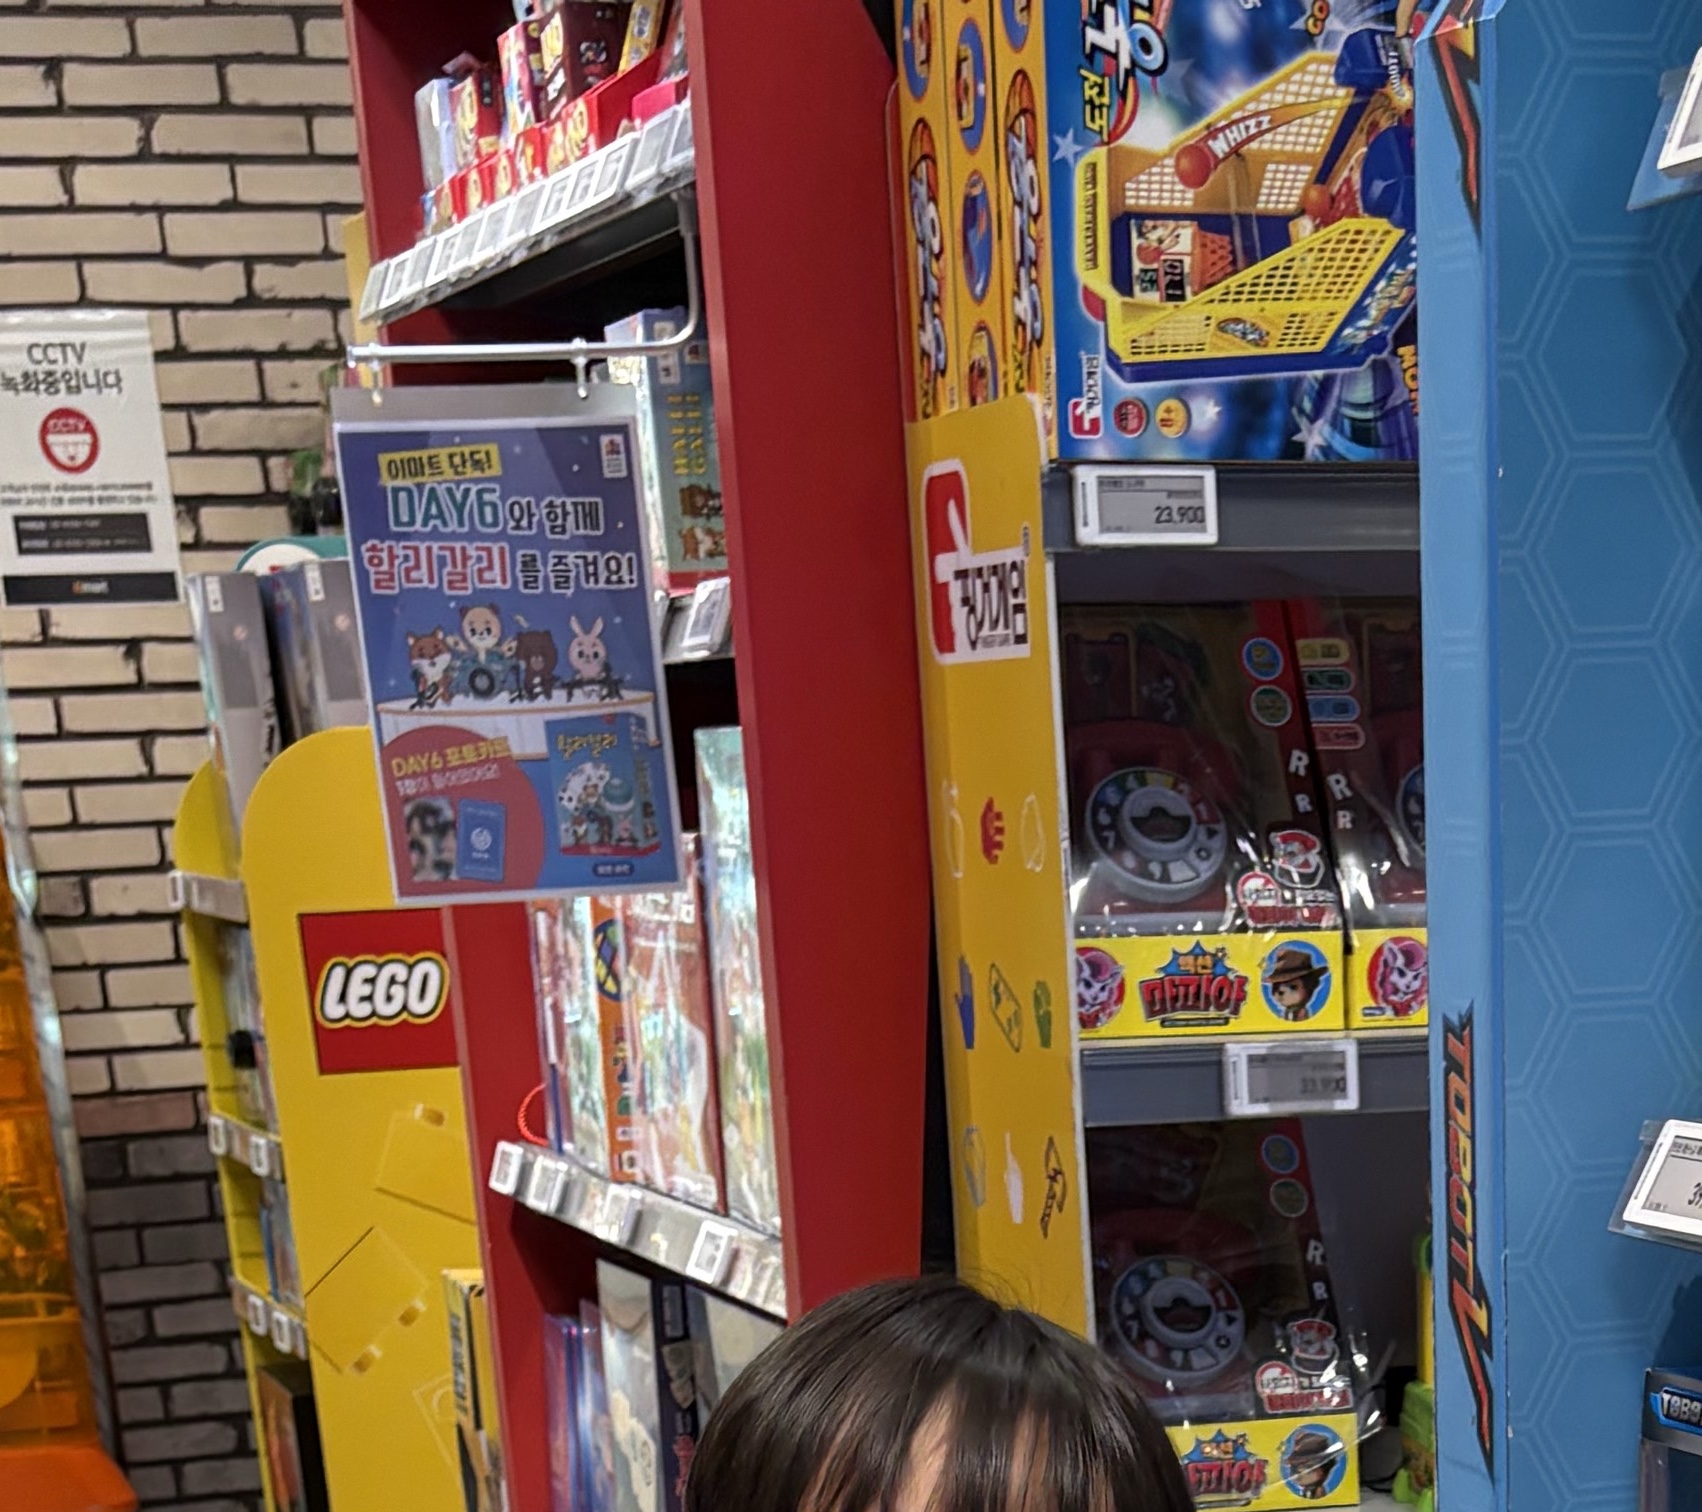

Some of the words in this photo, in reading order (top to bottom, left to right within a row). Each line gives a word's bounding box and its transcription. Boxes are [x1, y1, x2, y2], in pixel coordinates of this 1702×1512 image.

[1207, 113, 1272, 160] WHIZZ
[27, 342, 87, 365] CCTV
[0, 368, 123, 396] 녹화중입니다
[385, 456, 444, 480] 이마트
[448, 448, 492, 475] 단독!
[389, 484, 501, 530] DAY6
[508, 498, 538, 534] 와
[542, 498, 602, 537] 함께
[1153, 505, 1207, 525] 23,900
[362, 541, 510, 592] 할리갈리
[517, 552, 542, 591] 를
[548, 553, 636, 591] 즐겨요!
[320, 968, 440, 1024] LEGO
